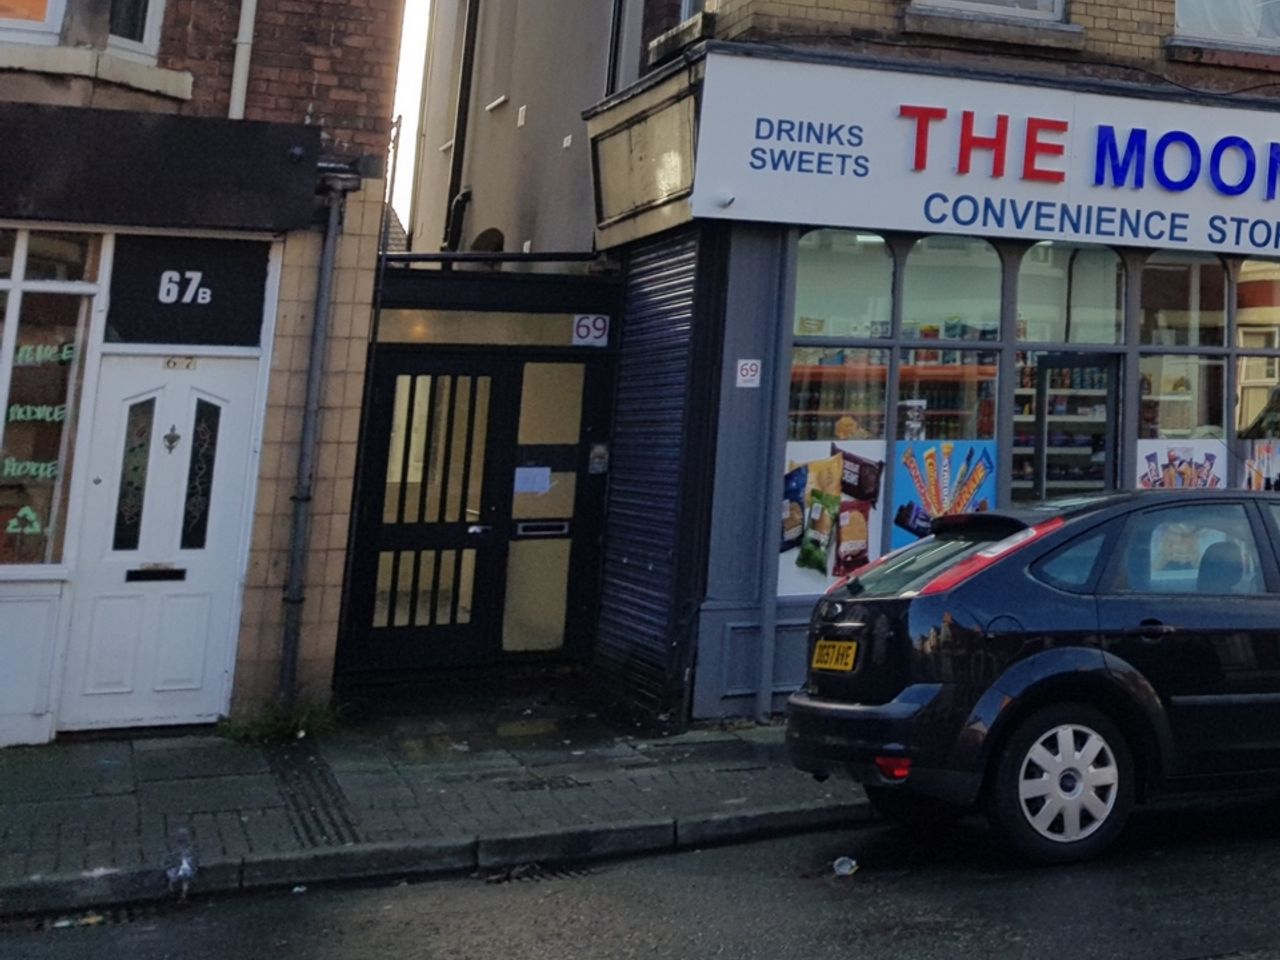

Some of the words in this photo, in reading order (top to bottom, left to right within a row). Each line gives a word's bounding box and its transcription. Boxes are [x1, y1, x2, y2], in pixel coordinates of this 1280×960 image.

[754, 117, 864, 148] DRINKS
[898, 104, 1069, 183] THE
[748, 147, 871, 178] SWEETS
[922, 191, 1190, 243] CONVENIENCE
[574, 315, 608, 340] 69
[740, 362, 759, 378] 69
